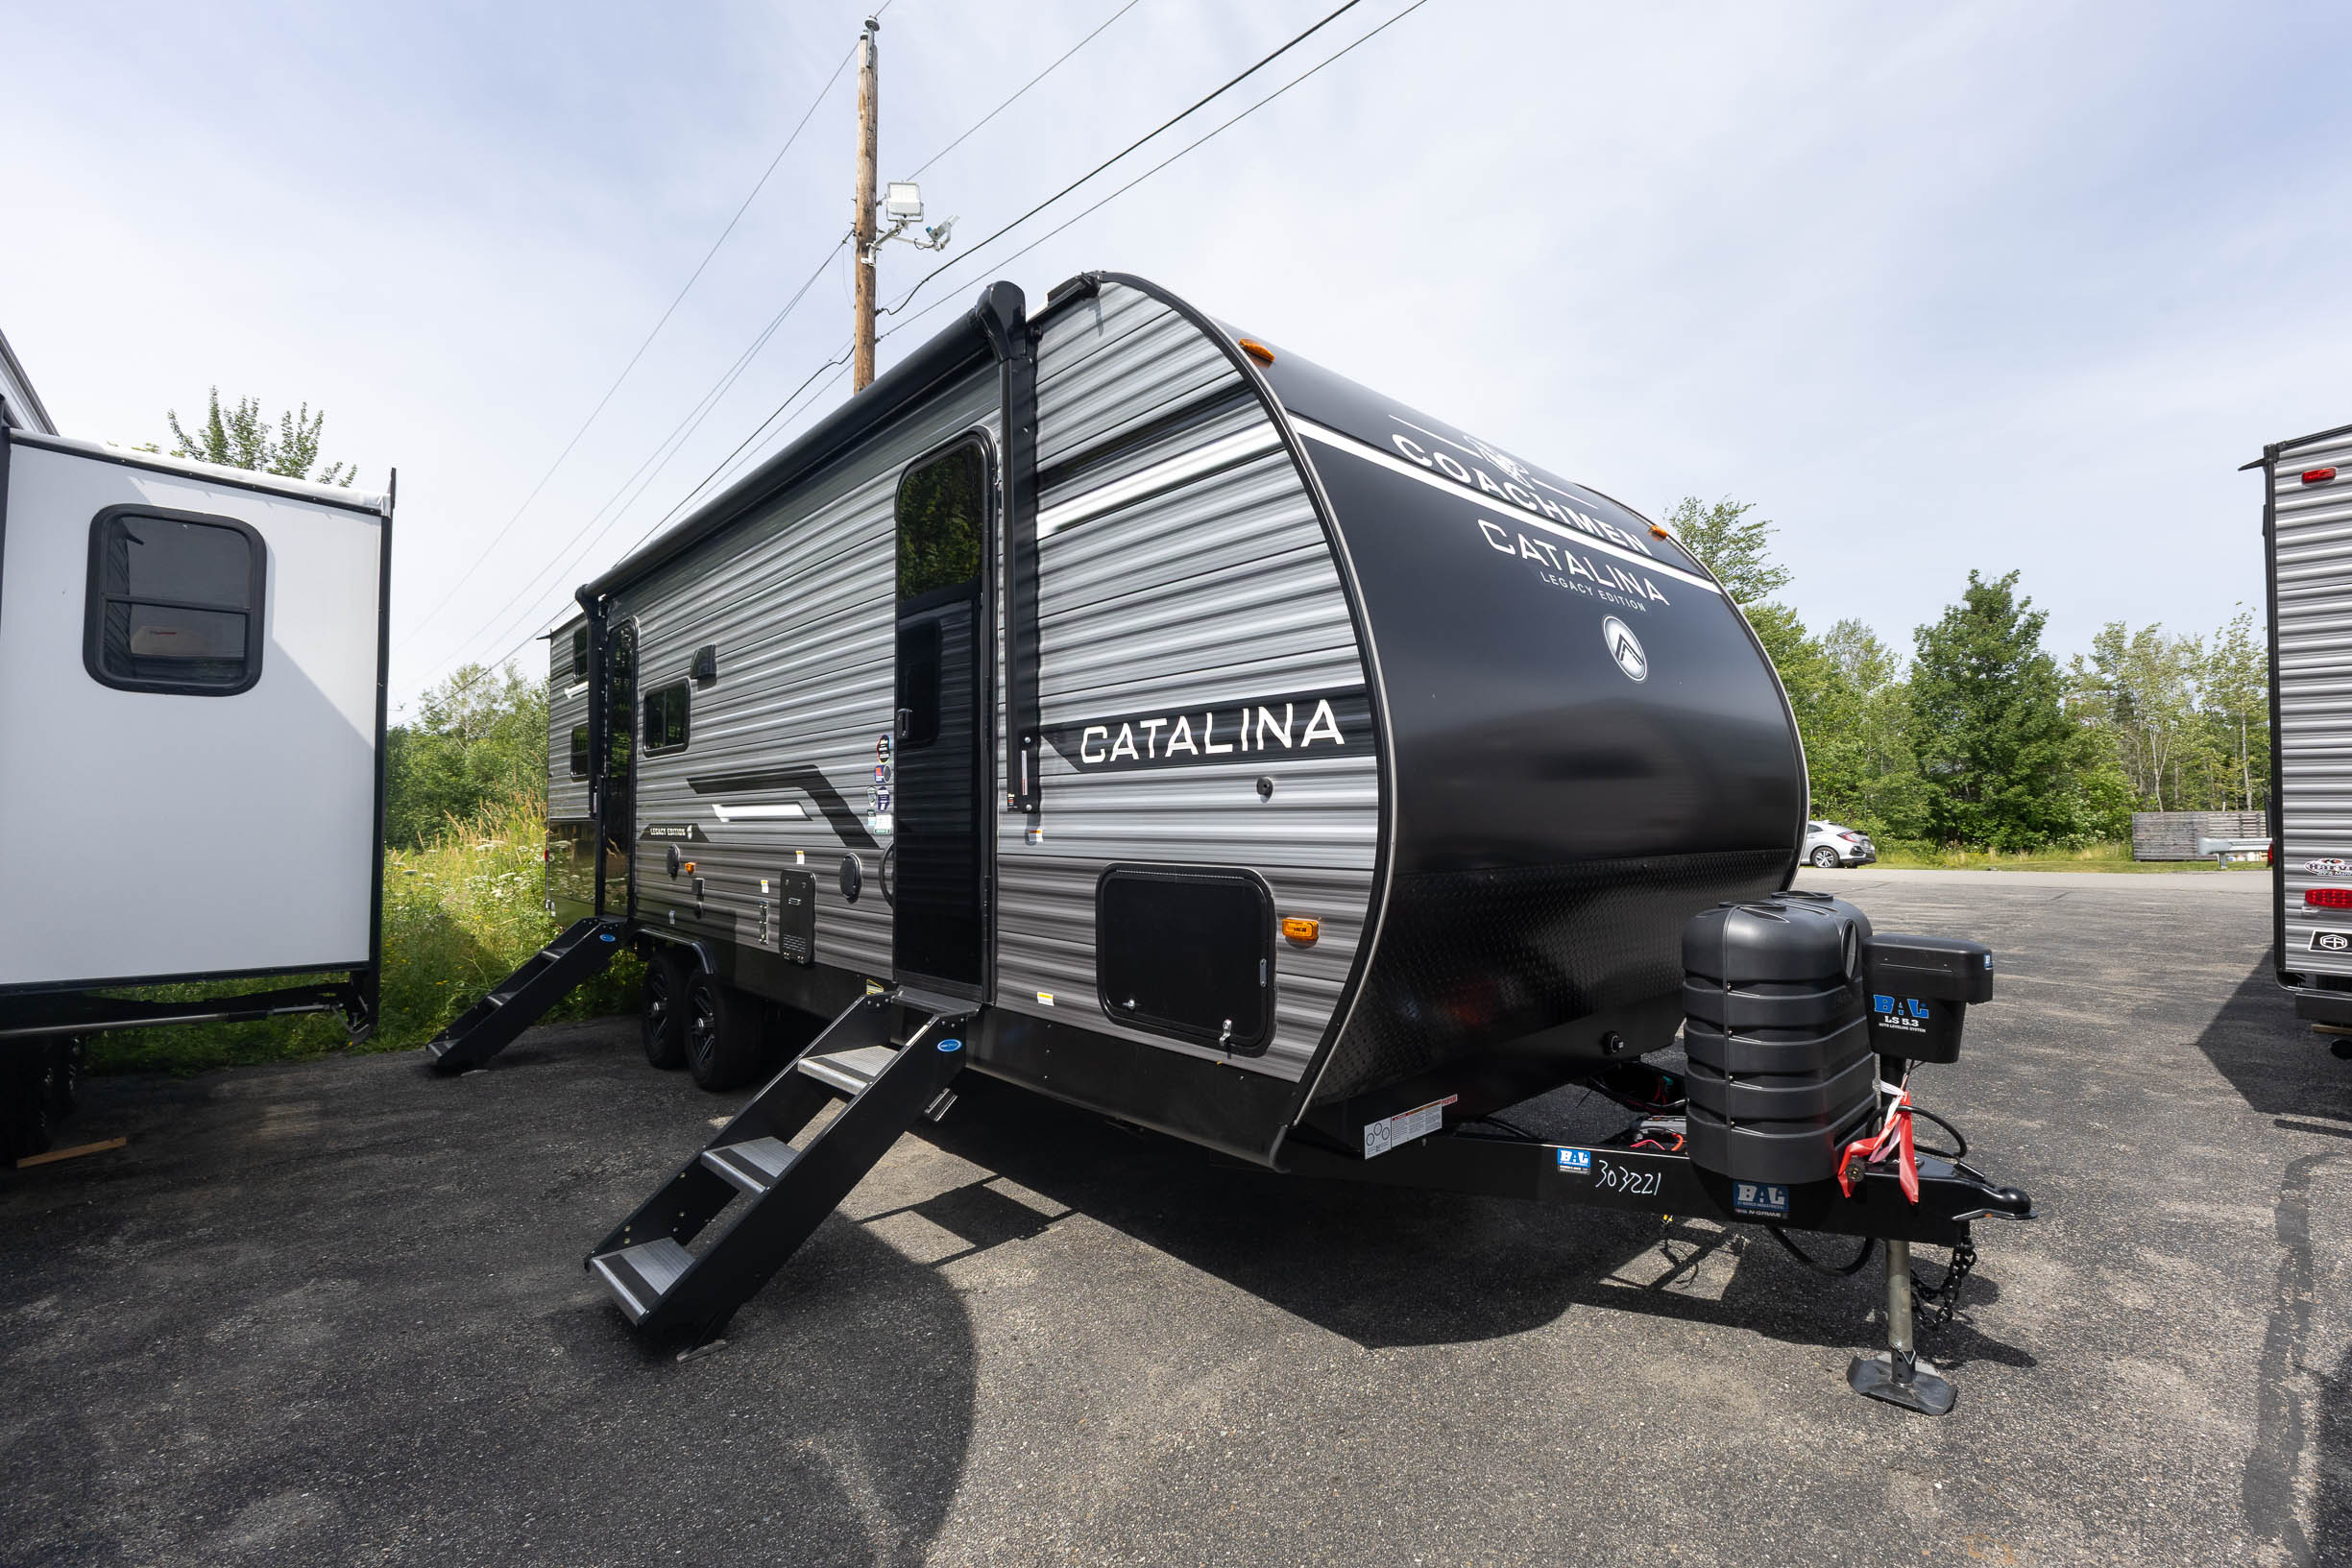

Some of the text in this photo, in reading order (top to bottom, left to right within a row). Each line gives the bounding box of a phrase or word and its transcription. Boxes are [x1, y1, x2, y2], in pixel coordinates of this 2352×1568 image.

[1393, 434, 1653, 556] COACHMEN
[1478, 519, 1670, 606] CATALINA
[1540, 570, 1646, 613] LEGACY EDITION
[1080, 699, 1346, 764] CATALINA
[1873, 994, 1929, 1019] BAL
[1884, 1015, 1919, 1027] LS 5.3
[1560, 1150, 1589, 1164] BAL
[1737, 1184, 1785, 1205] BAL
